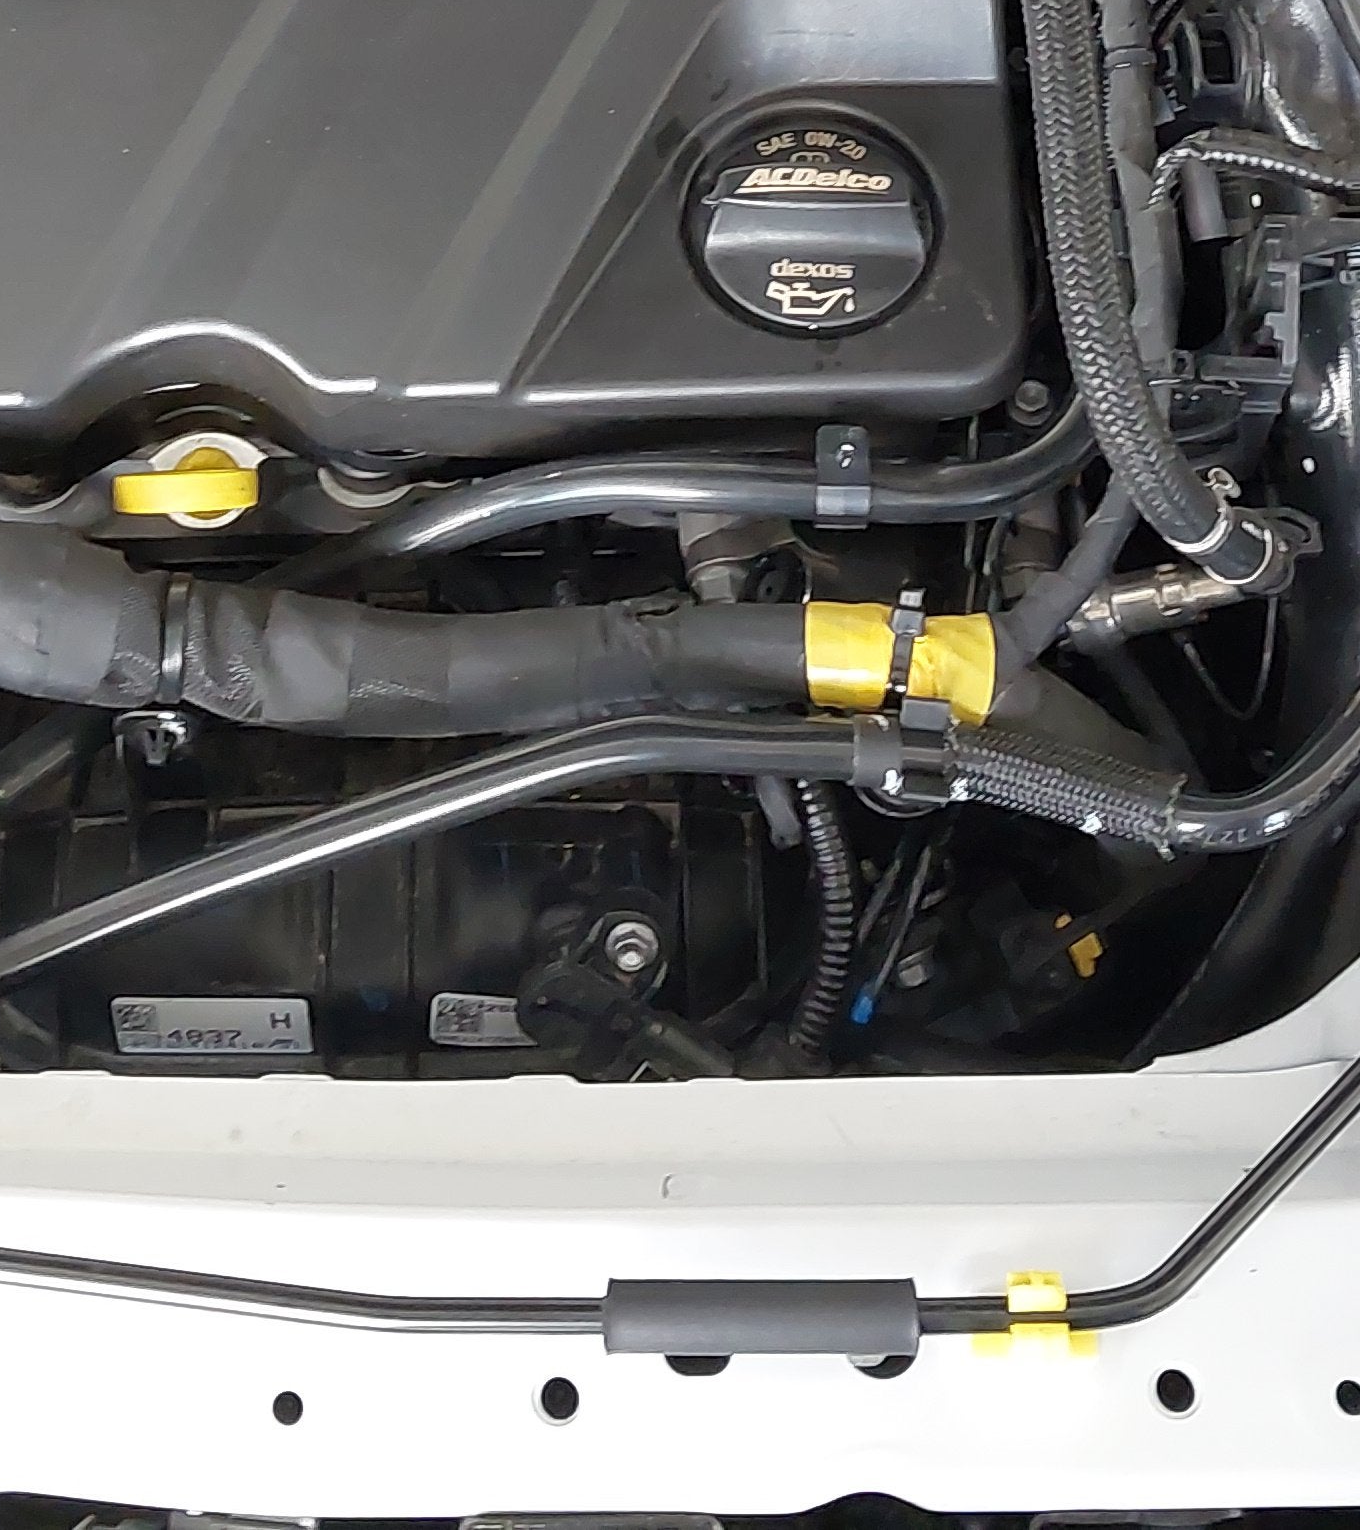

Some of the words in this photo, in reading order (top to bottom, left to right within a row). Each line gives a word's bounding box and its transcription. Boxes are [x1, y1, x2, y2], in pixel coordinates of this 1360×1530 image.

[756, 132, 797, 157] SAE
[742, 167, 892, 191] ACDelco
[769, 258, 855, 279] dexos
